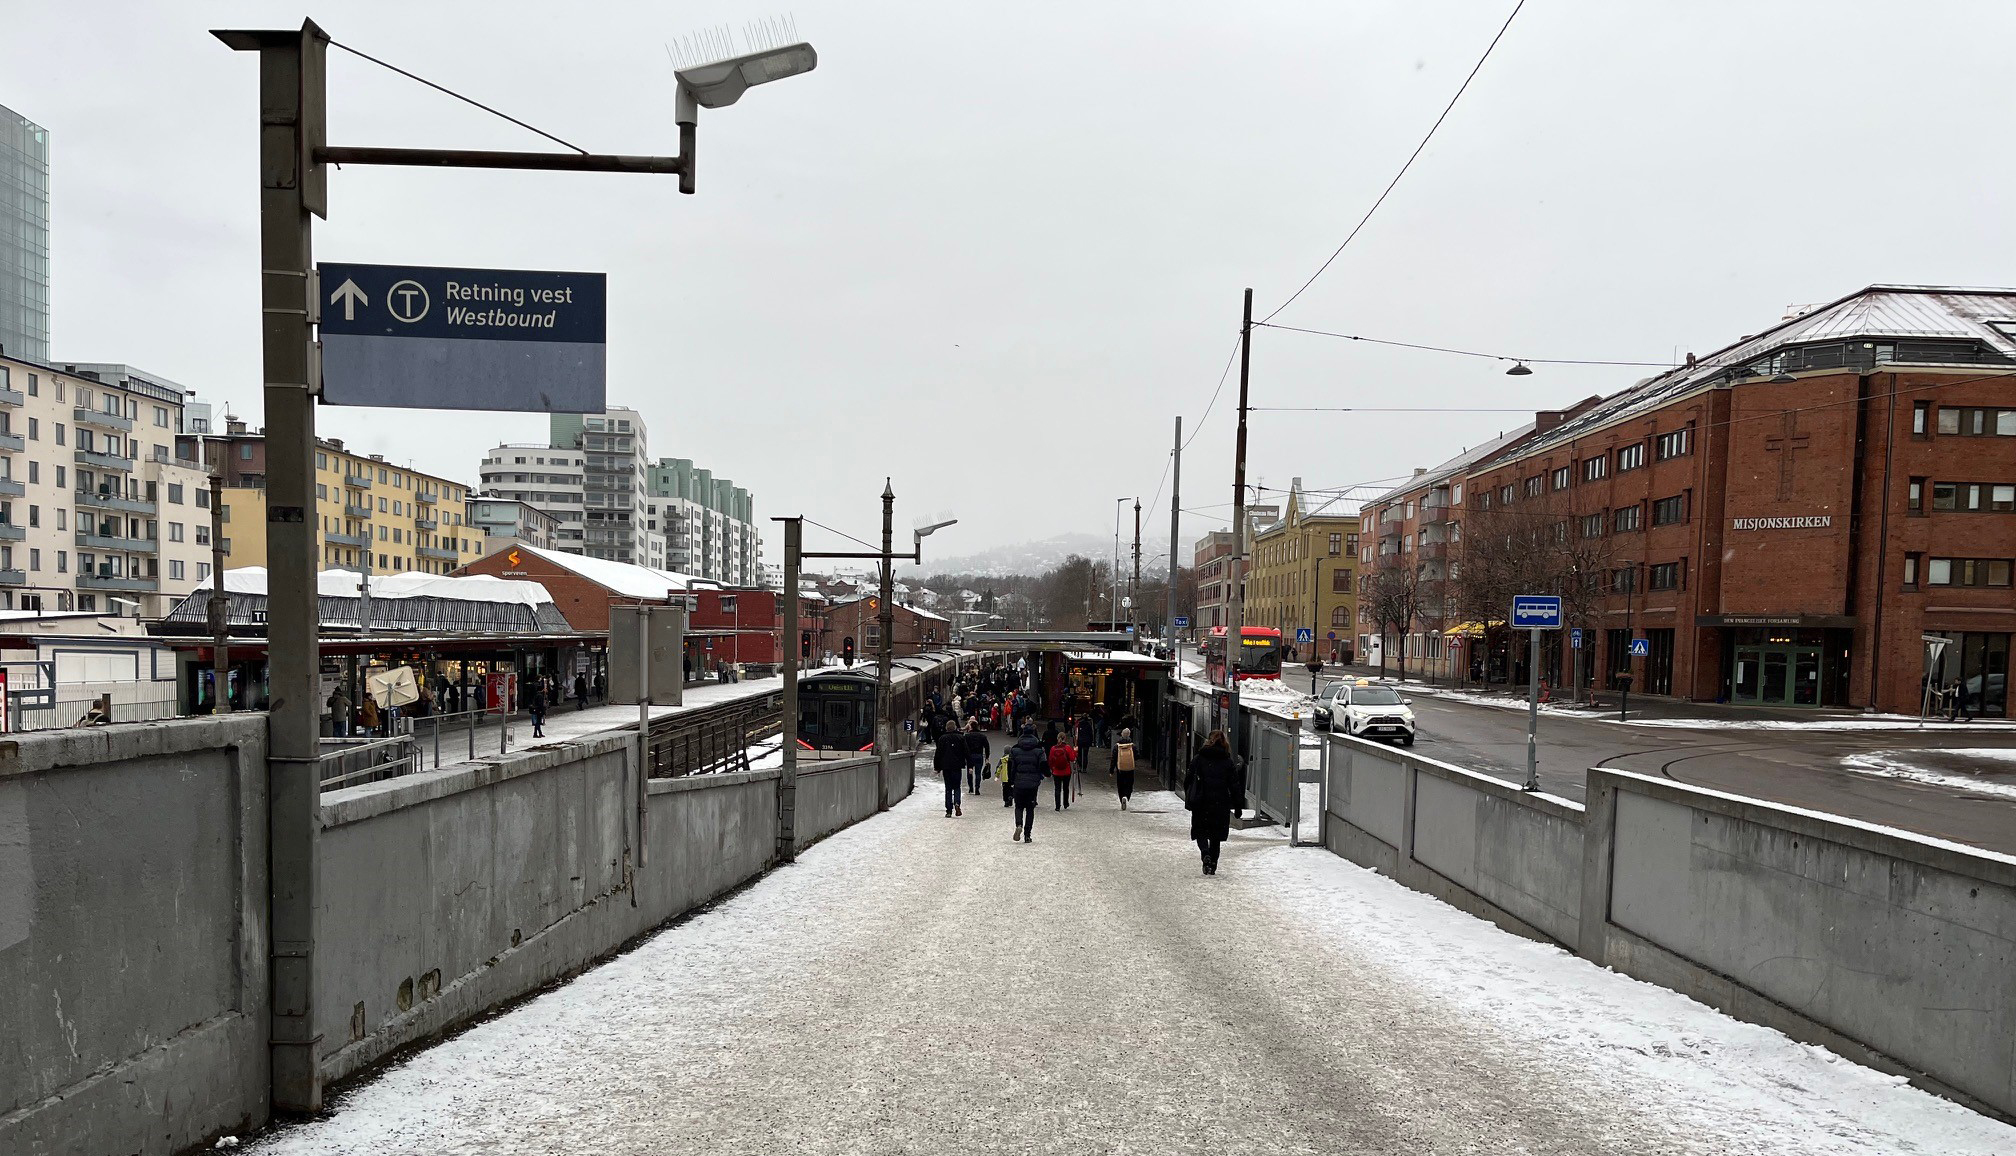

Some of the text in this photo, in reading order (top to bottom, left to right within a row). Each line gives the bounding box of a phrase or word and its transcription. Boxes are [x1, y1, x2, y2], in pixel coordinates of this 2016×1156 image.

[398, 290, 420, 318] T
[446, 281, 572, 306] Retning vest
[446, 306, 556, 328] Westbound
[1733, 516, 1831, 531] MISJONSKIRKEN
[906, 723, 912, 731] 3
